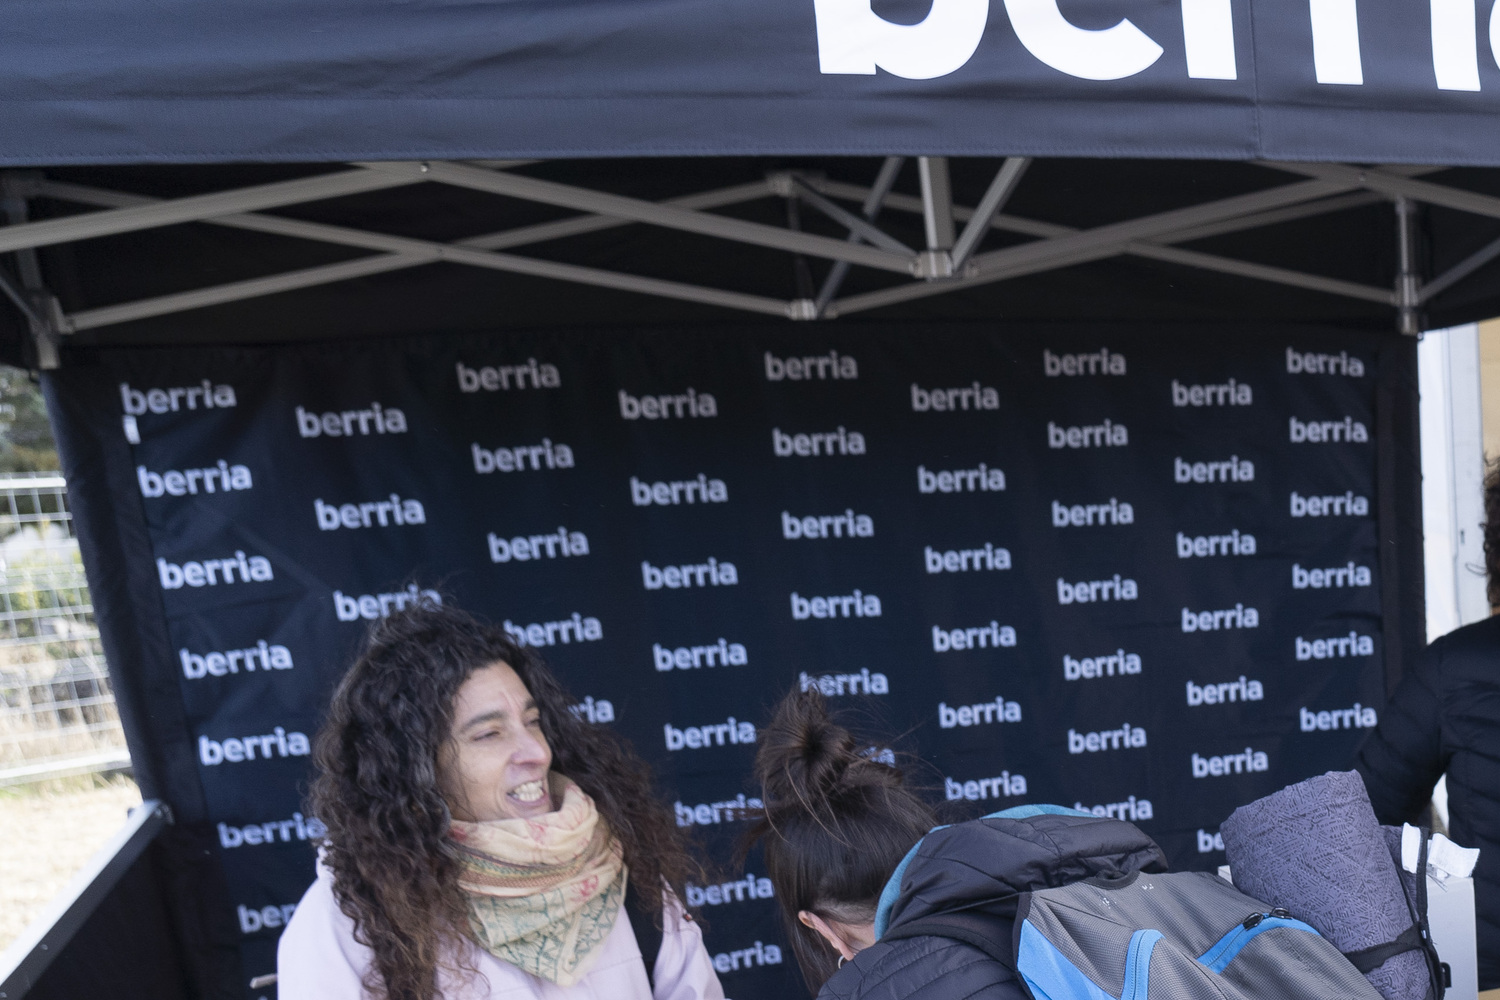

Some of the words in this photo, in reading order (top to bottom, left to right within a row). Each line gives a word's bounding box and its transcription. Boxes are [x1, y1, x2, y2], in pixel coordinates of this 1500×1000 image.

[457, 358, 560, 392] berria
[765, 351, 857, 380] berria
[1044, 348, 1126, 376] berria
[1286, 348, 1364, 377] berria
[119, 378, 238, 416] berria
[619, 389, 717, 419] berria
[911, 382, 999, 411] berria
[1172, 378, 1252, 406] berria
[296, 402, 407, 437] berria
[1048, 419, 1128, 448] berria
[1290, 416, 1368, 443] berria
[472, 438, 574, 473] berria
[773, 427, 866, 456] berria
[136, 460, 253, 497] berria
[917, 463, 1006, 493] berria
[1175, 455, 1254, 483] berria
[630, 474, 728, 506] berria
[1290, 491, 1368, 517] berria
[314, 494, 426, 530] berria
[781, 509, 874, 539] berria
[1052, 498, 1134, 527] berria
[487, 526, 589, 563] berria
[924, 543, 1011, 574] berria
[1176, 529, 1256, 558] berria
[156, 550, 274, 589] berria
[641, 557, 738, 590] berria
[1292, 561, 1371, 589] berria
[790, 589, 882, 620] berria
[1057, 574, 1138, 605] berria
[1182, 603, 1259, 632] berria
[932, 621, 1017, 652] berria
[1295, 631, 1374, 660] berria
[179, 640, 293, 679] berria
[653, 638, 748, 671] berria
[1063, 649, 1142, 681] berria
[1186, 676, 1264, 706] berria
[938, 696, 1022, 728] berria
[1300, 703, 1377, 732] berria
[198, 726, 311, 766] berria
[664, 717, 757, 751] berria
[1068, 723, 1147, 754] berria
[1192, 747, 1268, 778] berria
[945, 770, 1027, 802] berria
[685, 873, 775, 907] berria
[237, 904, 296, 933] ber
[709, 940, 782, 973] erria
